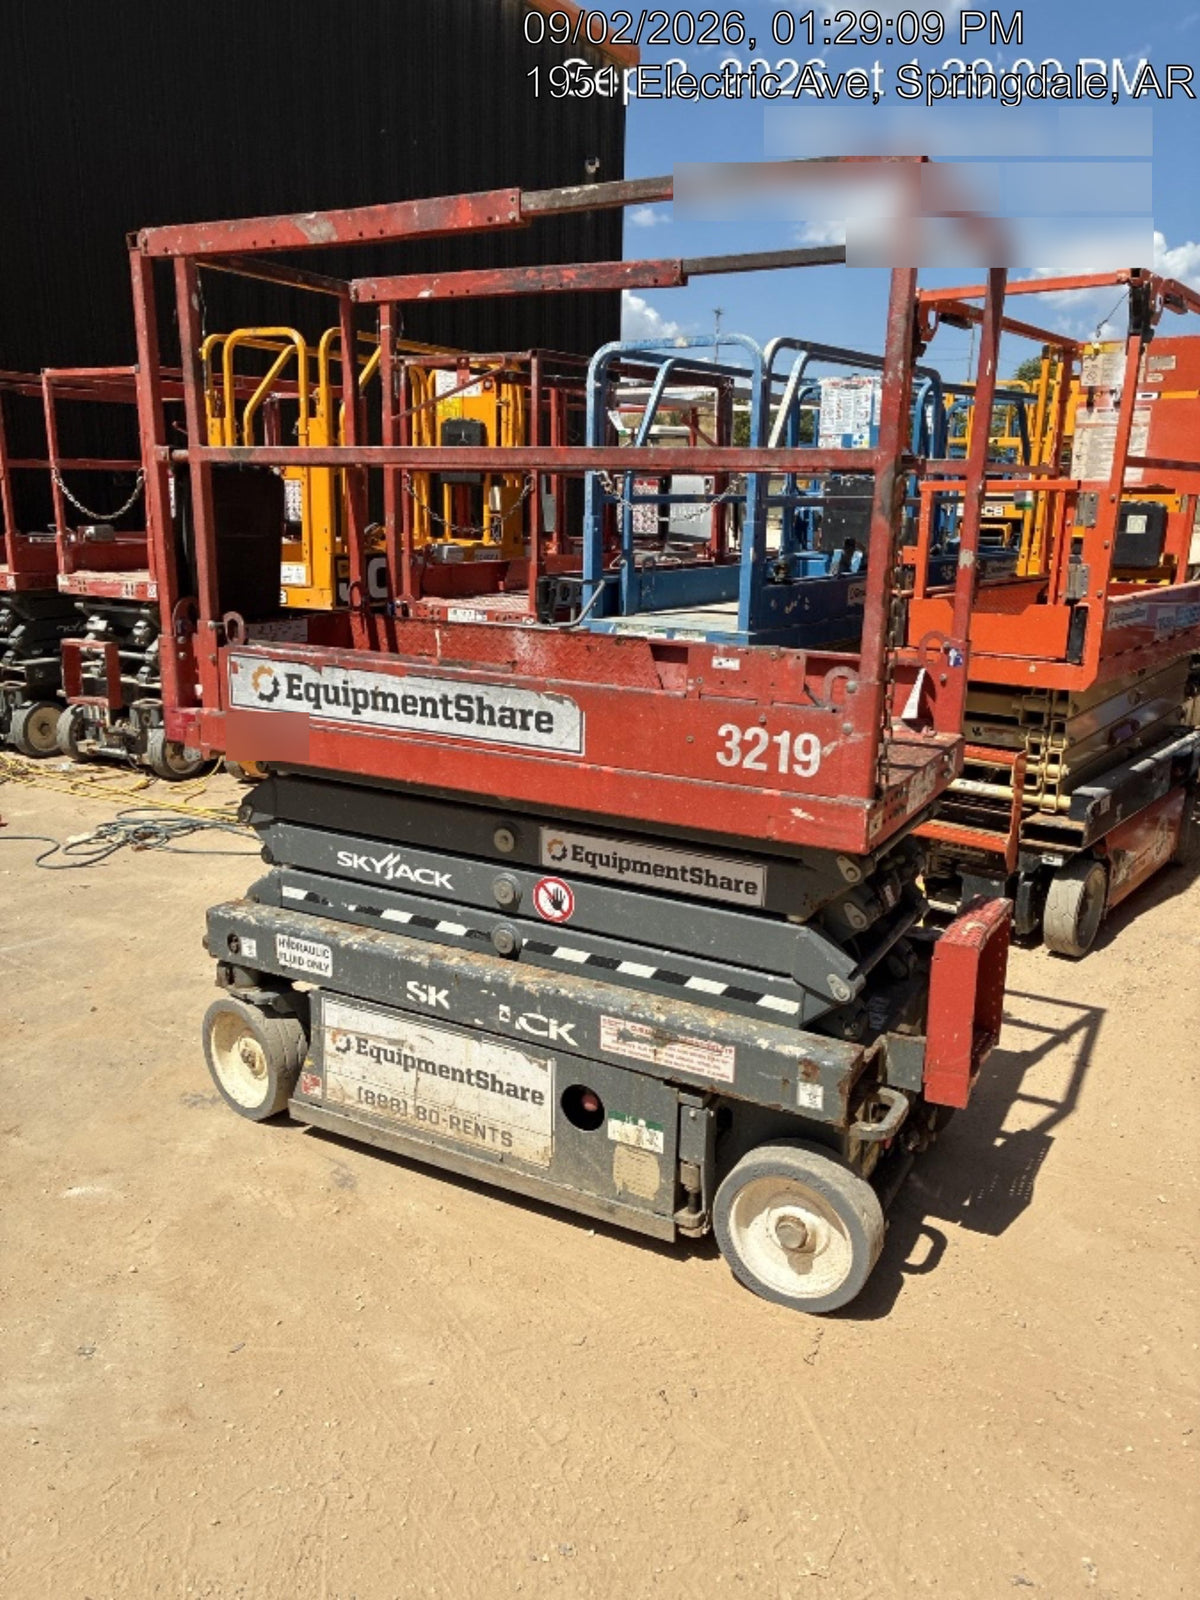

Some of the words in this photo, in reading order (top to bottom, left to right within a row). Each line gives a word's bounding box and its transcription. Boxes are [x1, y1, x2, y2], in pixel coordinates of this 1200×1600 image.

[285, 672, 554, 734] EquipmentShare
[716, 723, 821, 778] 3219
[337, 851, 454, 891] SKYJACK
[571, 844, 758, 896] EquipmentShare
[278, 938, 330, 959] HYDRAULIC
[280, 952, 305, 966] FLUID
[306, 959, 330, 973] ONLY
[355, 1034, 545, 1106] EquipmentShare
